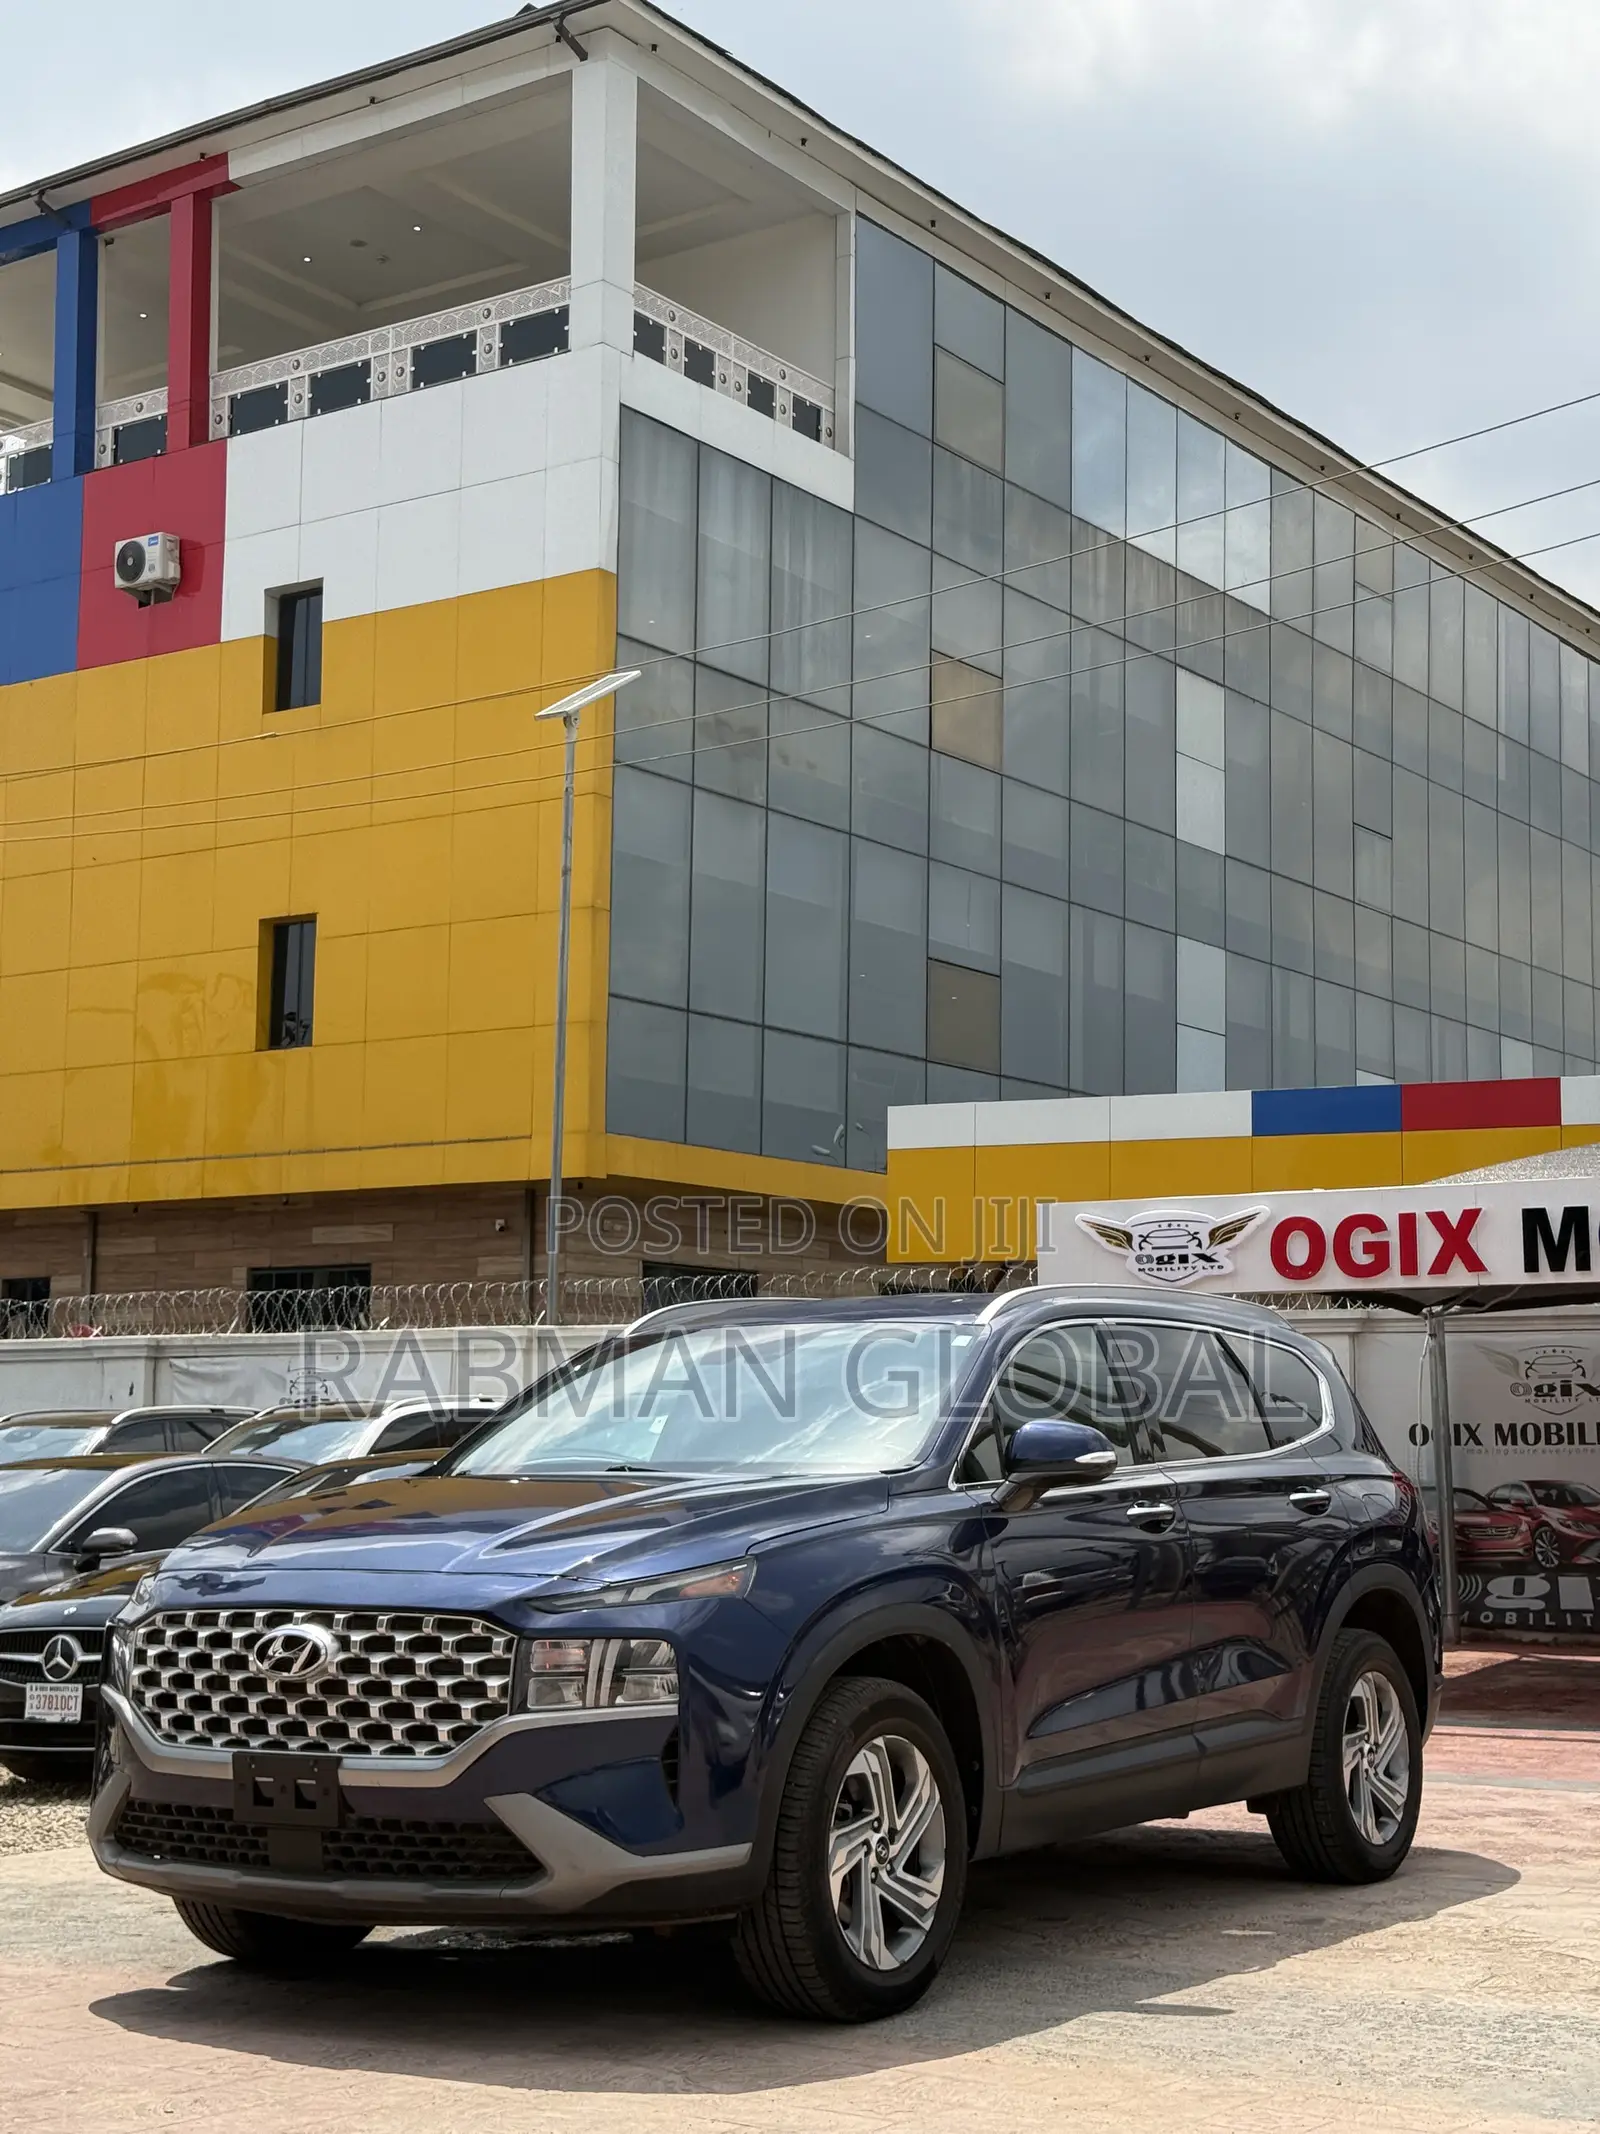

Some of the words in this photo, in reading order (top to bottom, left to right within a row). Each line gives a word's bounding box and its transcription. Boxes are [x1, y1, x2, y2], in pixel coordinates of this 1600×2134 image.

[1270, 1207, 1489, 1281] OGIX
[1521, 1205, 1600, 1273] M
[1409, 1423, 1483, 1446] OIX
